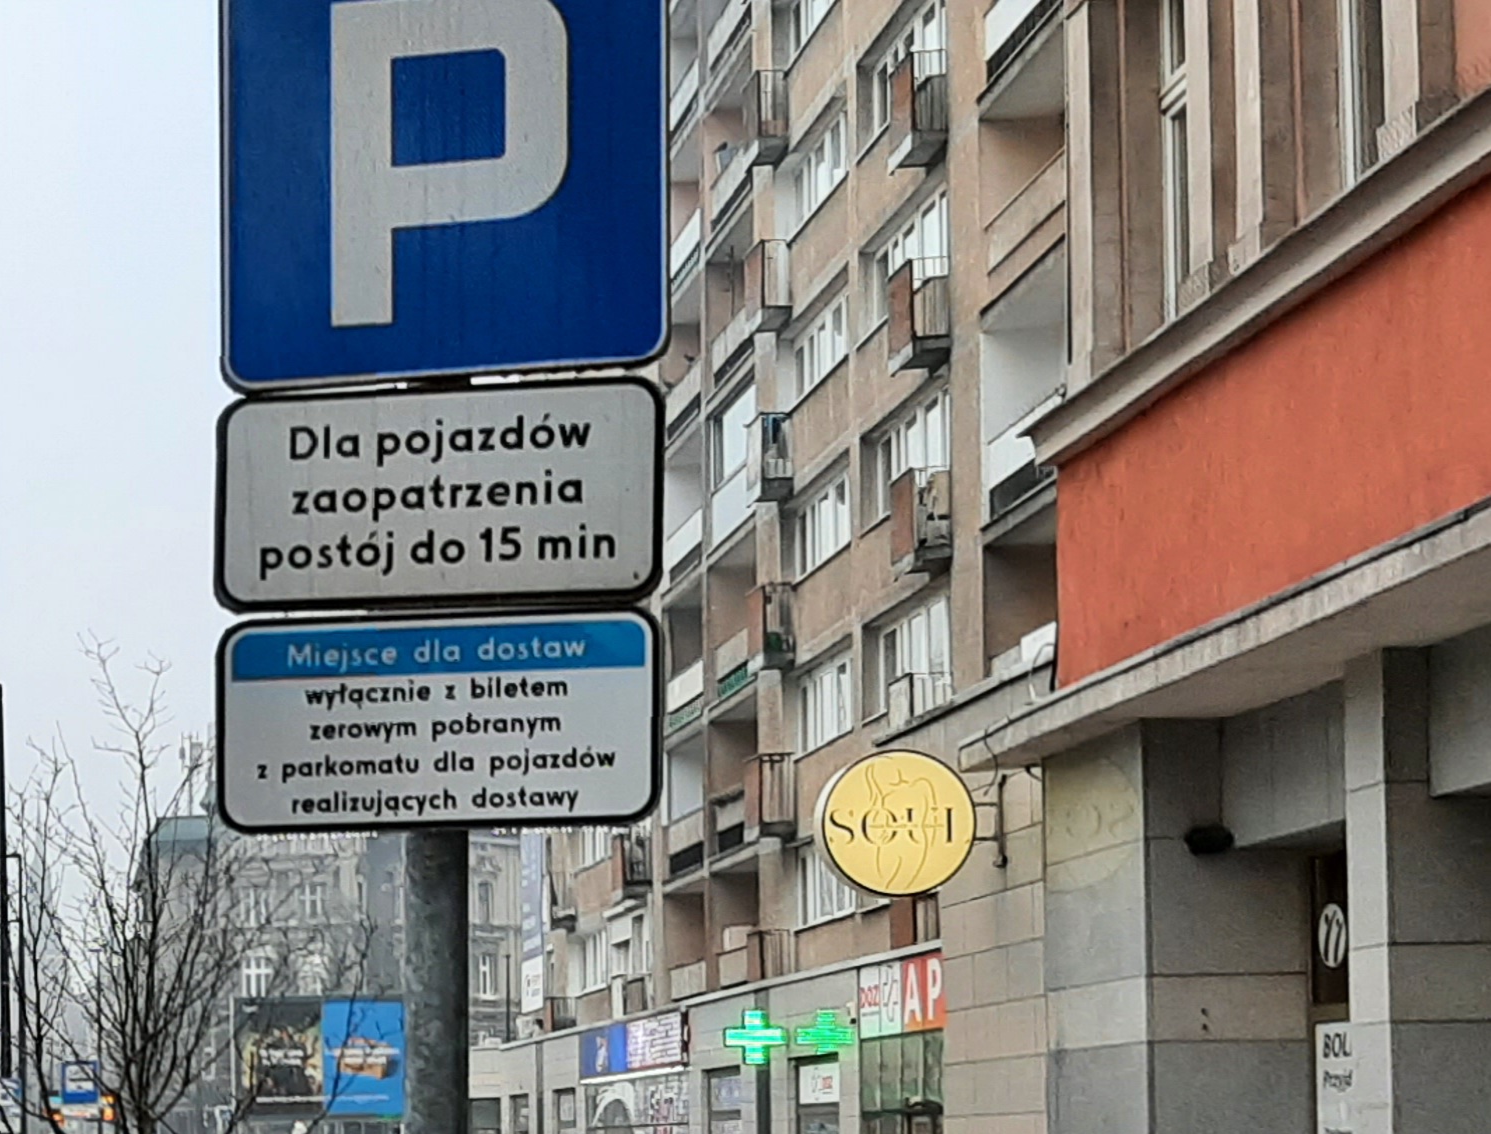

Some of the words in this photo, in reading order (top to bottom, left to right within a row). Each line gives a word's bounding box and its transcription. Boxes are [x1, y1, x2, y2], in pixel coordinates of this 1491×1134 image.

[331, 0, 568, 327] P
[289, 424, 360, 461] Dla
[376, 412, 592, 468] pojazdów
[291, 468, 583, 524] zaopatrzenia
[259, 530, 395, 582] postój
[409, 528, 466, 565] do
[478, 525, 522, 563] 15
[537, 522, 616, 561] min
[287, 641, 398, 673] Miejsce
[414, 638, 461, 663] dla
[477, 636, 586, 661] dostaw
[304, 679, 431, 712] wyłącznie
[445, 684, 456, 701] z
[470, 676, 568, 700] biletem
[309, 721, 417, 744] zerowym
[431, 712, 562, 743] pobranym
[256, 763, 268, 780] z
[281, 753, 420, 785] parkomatu
[433, 750, 475, 773] dla
[489, 745, 616, 778] pojazdów
[291, 787, 458, 818] realizujących
[471, 786, 579, 813] dostawy
